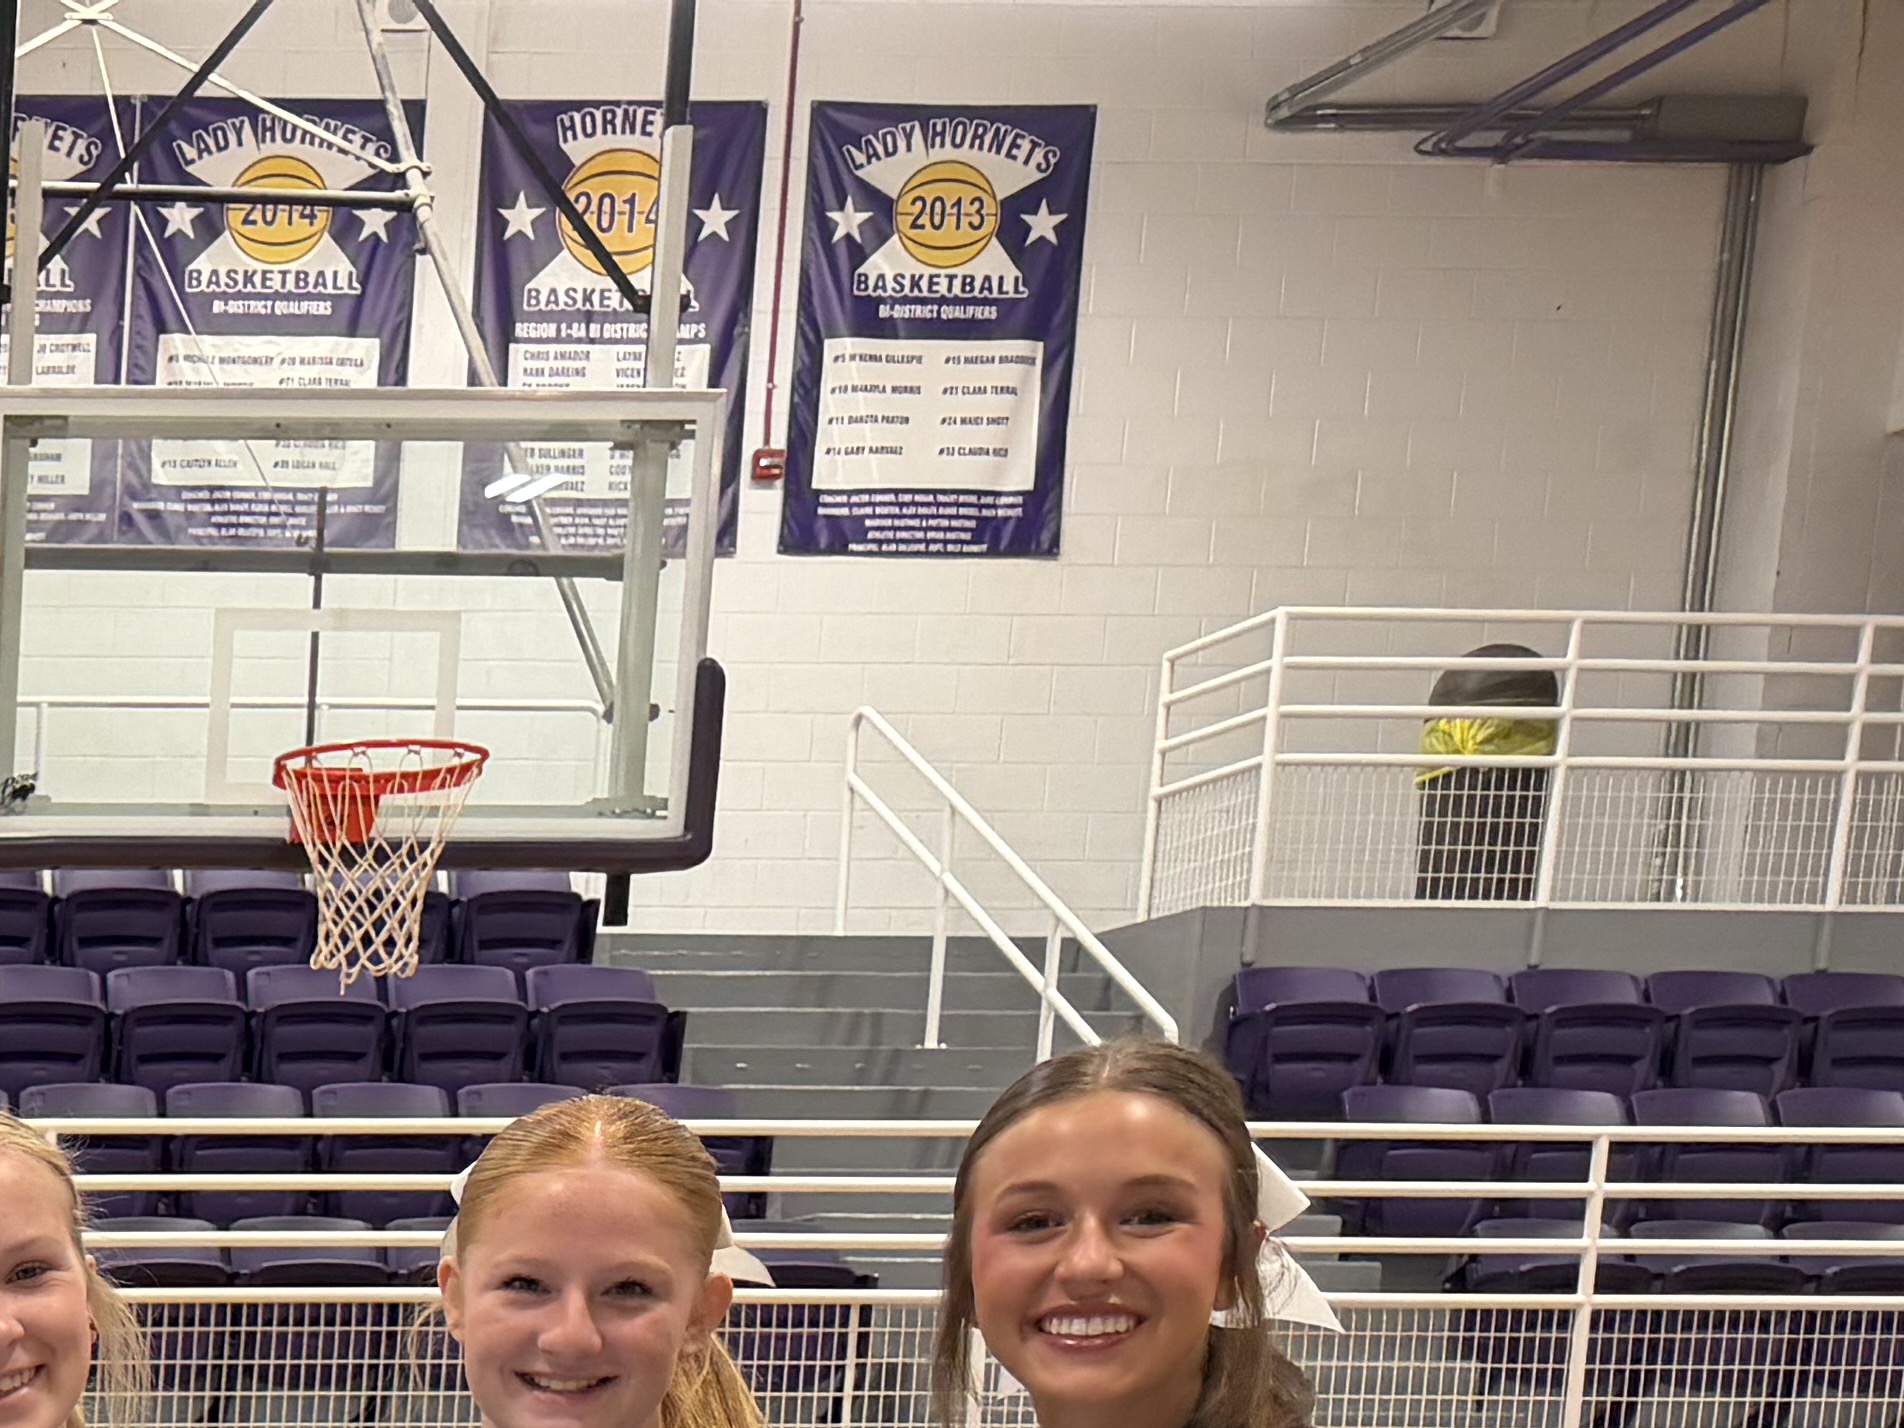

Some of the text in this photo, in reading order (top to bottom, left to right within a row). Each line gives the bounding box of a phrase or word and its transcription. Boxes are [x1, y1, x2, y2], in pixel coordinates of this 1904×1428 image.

[174, 117, 246, 168] LADY
[560, 106, 664, 144] HORNE
[845, 118, 1059, 175] LADY HORNETS
[908, 195, 986, 231] 2013
[187, 268, 362, 291] BASKETBALL
[855, 272, 1028, 296] BASKETBALL
[602, 323, 648, 339] DISTRIC
